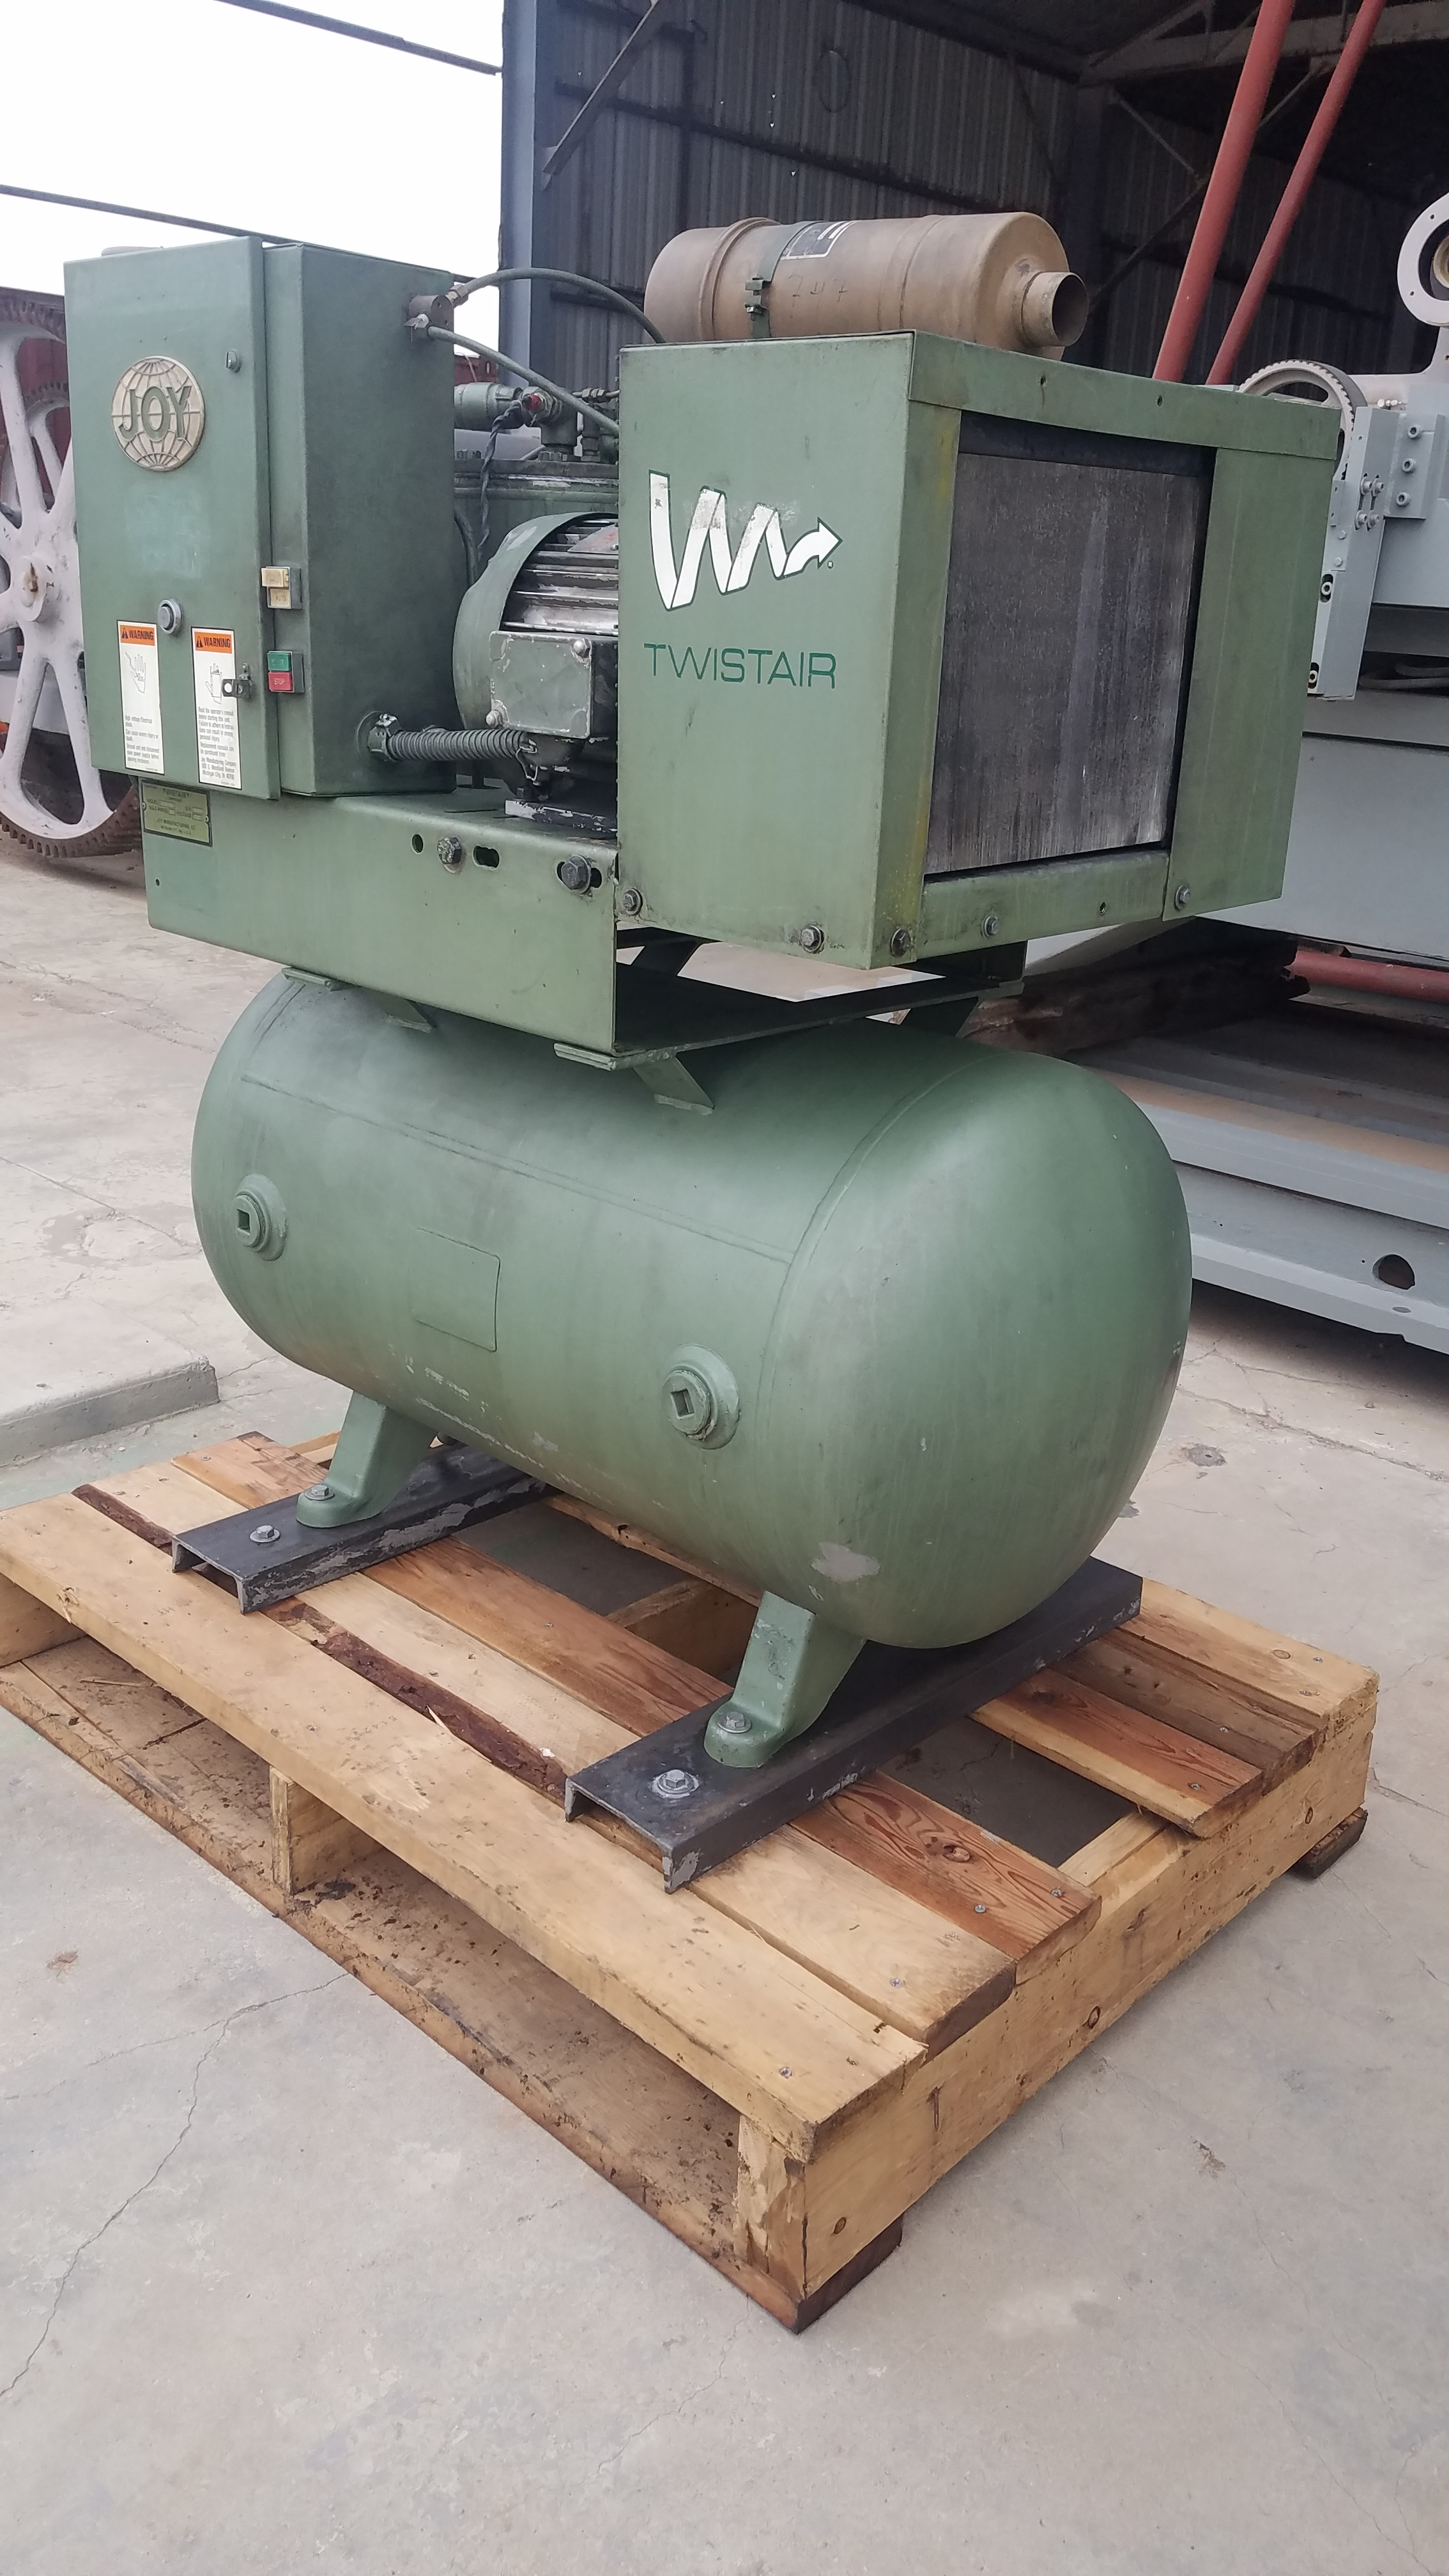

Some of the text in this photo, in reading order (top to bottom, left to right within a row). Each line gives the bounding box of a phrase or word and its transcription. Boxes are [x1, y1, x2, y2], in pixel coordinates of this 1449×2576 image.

[119, 386, 192, 442] JOY
[128, 629, 154, 640] WARNING
[203, 637, 231, 648] WARNING
[644, 643, 836, 689] TWISTAIR
